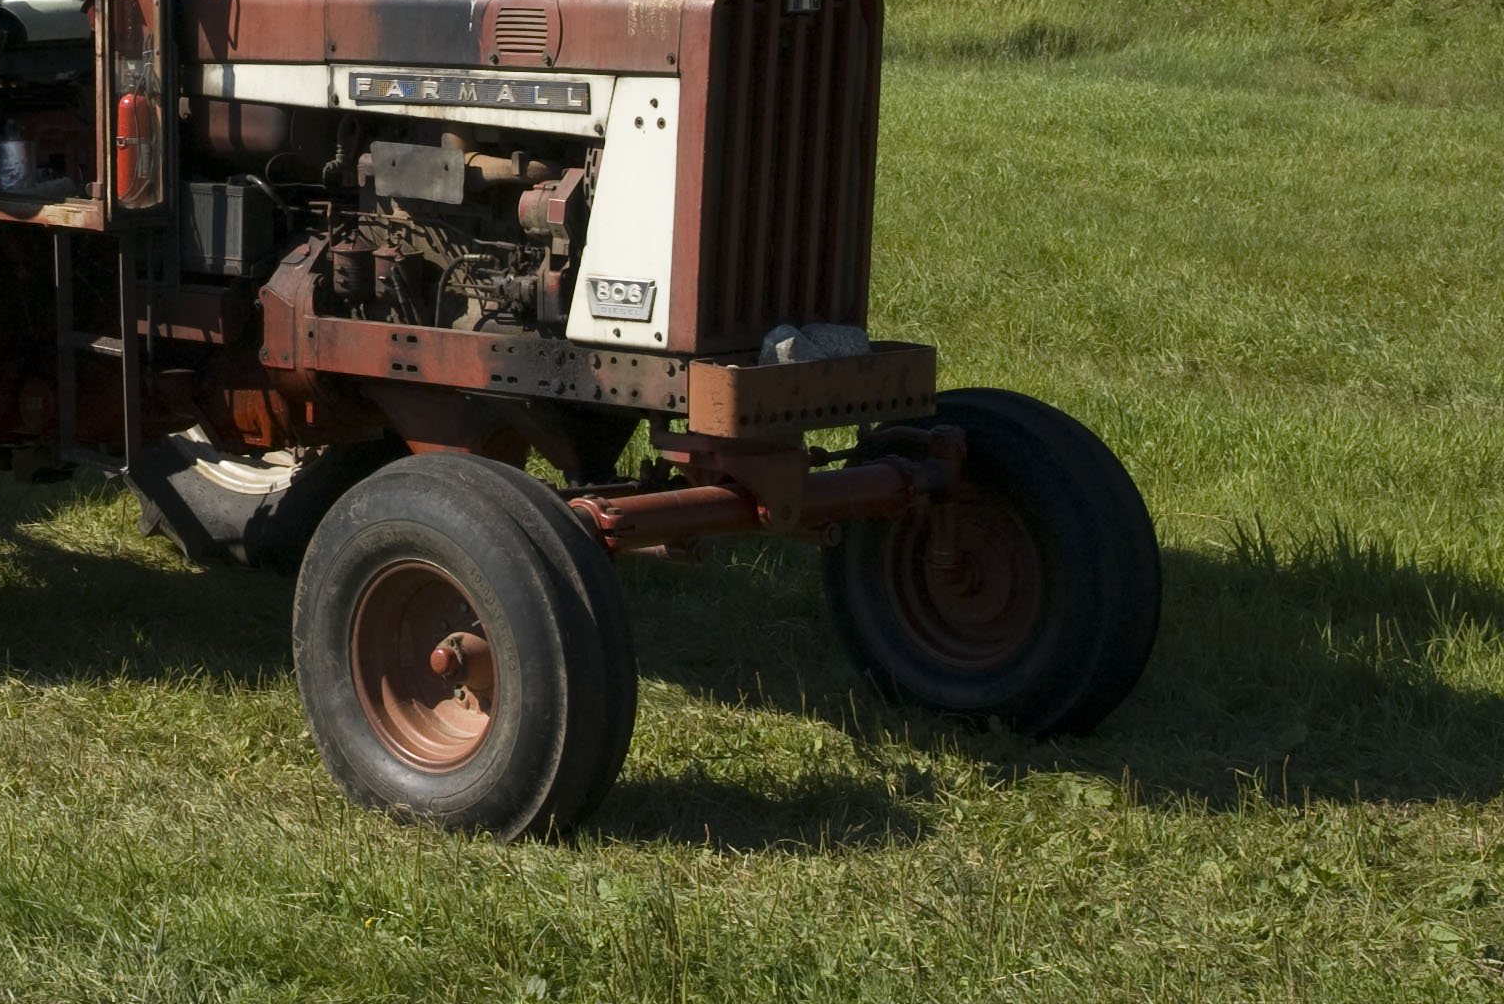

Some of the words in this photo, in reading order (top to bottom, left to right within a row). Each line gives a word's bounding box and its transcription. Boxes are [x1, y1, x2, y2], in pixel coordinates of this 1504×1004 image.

[355, 77, 583, 107] FARMALL
[597, 281, 643, 303] 806
[600, 306, 641, 317] DIESEL
